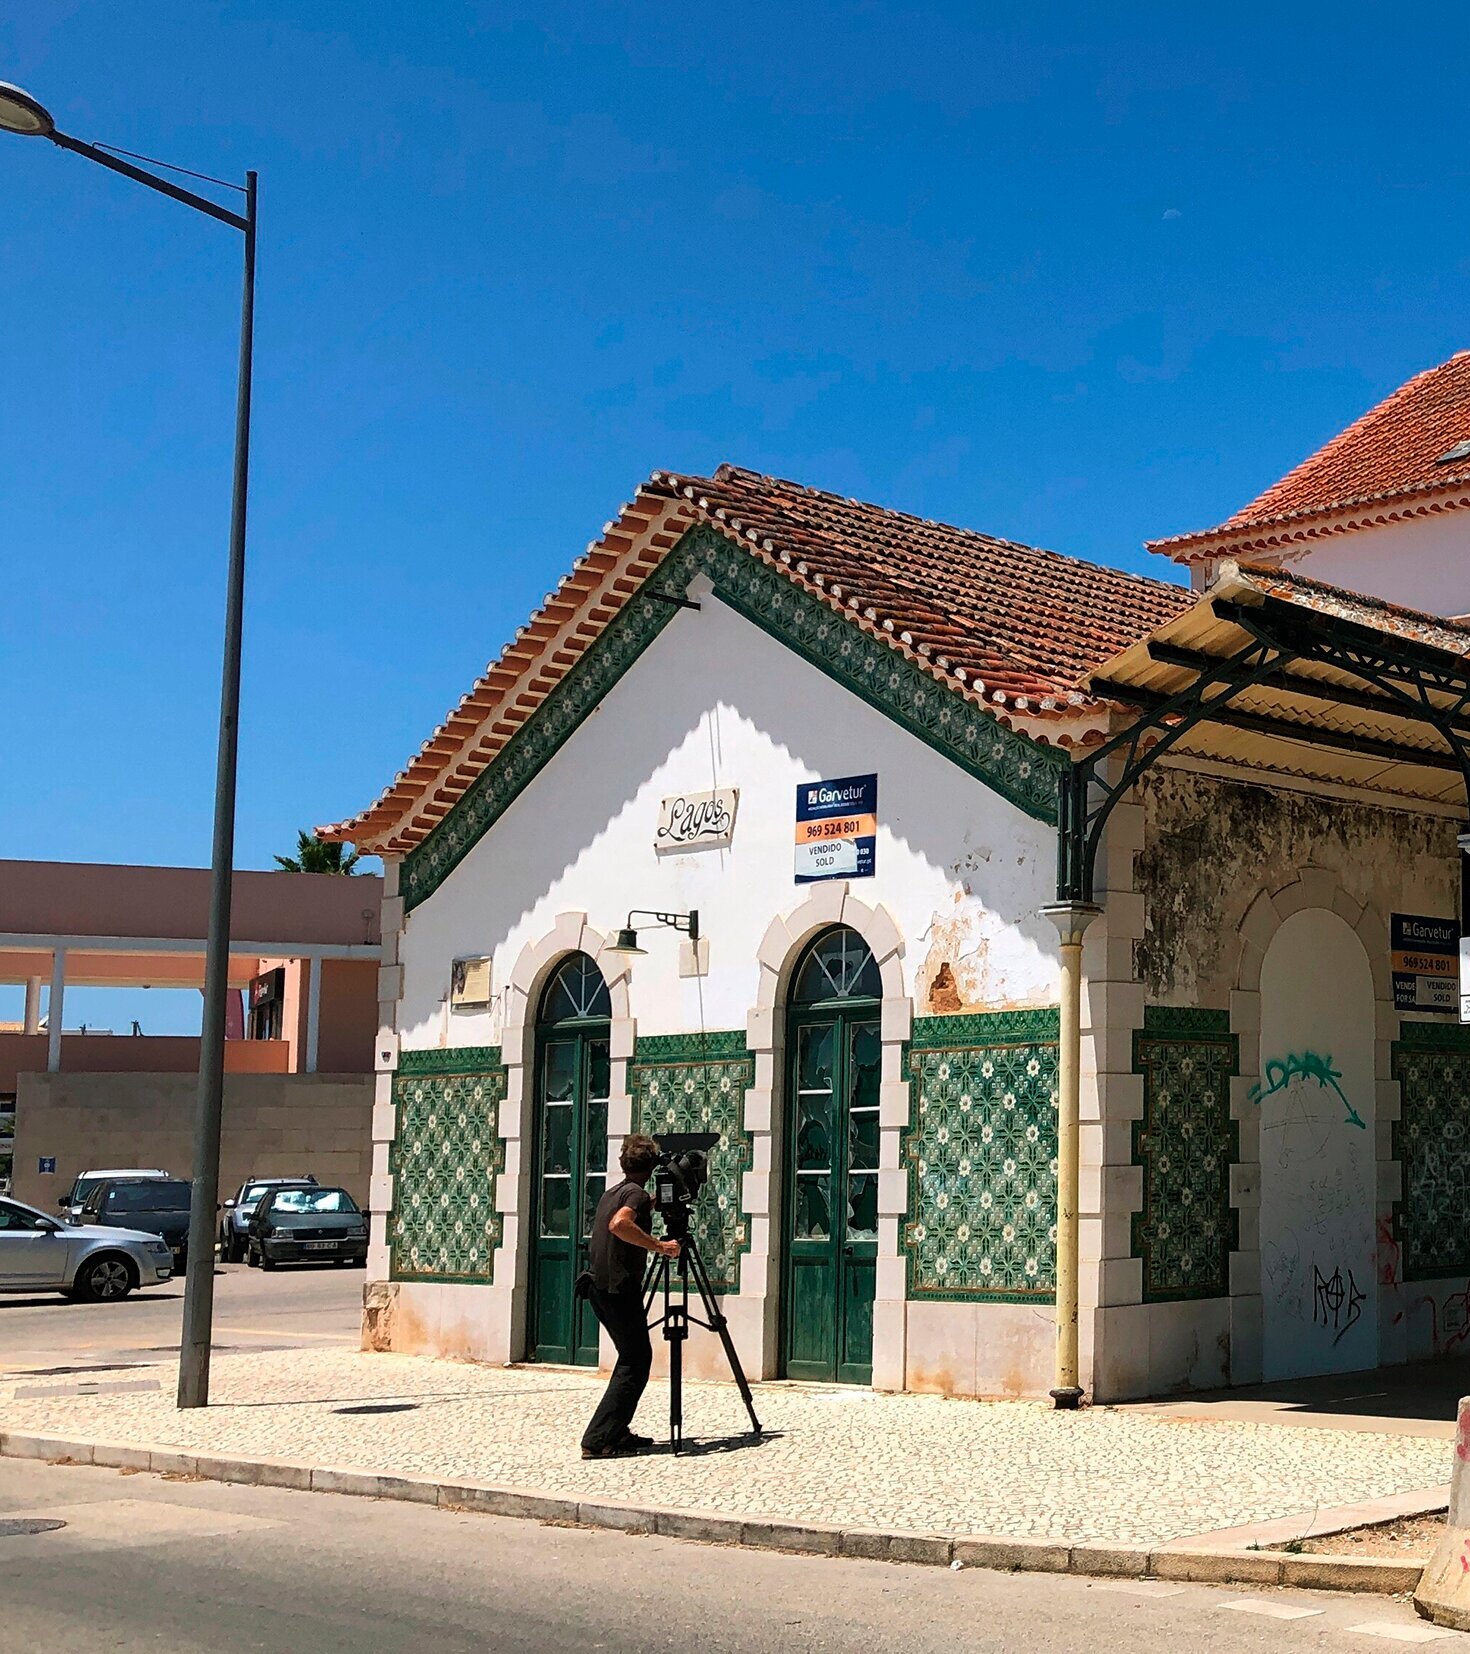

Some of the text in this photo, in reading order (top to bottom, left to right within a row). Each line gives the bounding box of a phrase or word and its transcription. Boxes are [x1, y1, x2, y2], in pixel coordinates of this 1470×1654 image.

[818, 785, 864, 803] Garvetur
[657, 797, 731, 842] Lagos
[806, 820, 860, 838] 969 524 801
[809, 842, 842, 856] VENDIDO
[815, 856, 835, 867] SOLD
[1412, 922, 1451, 940] Garvetur
[1403, 955, 1450, 971] 969 524 801
[1426, 981, 1456, 991] VENDIDO
[1433, 993, 1450, 1002] SOLD
